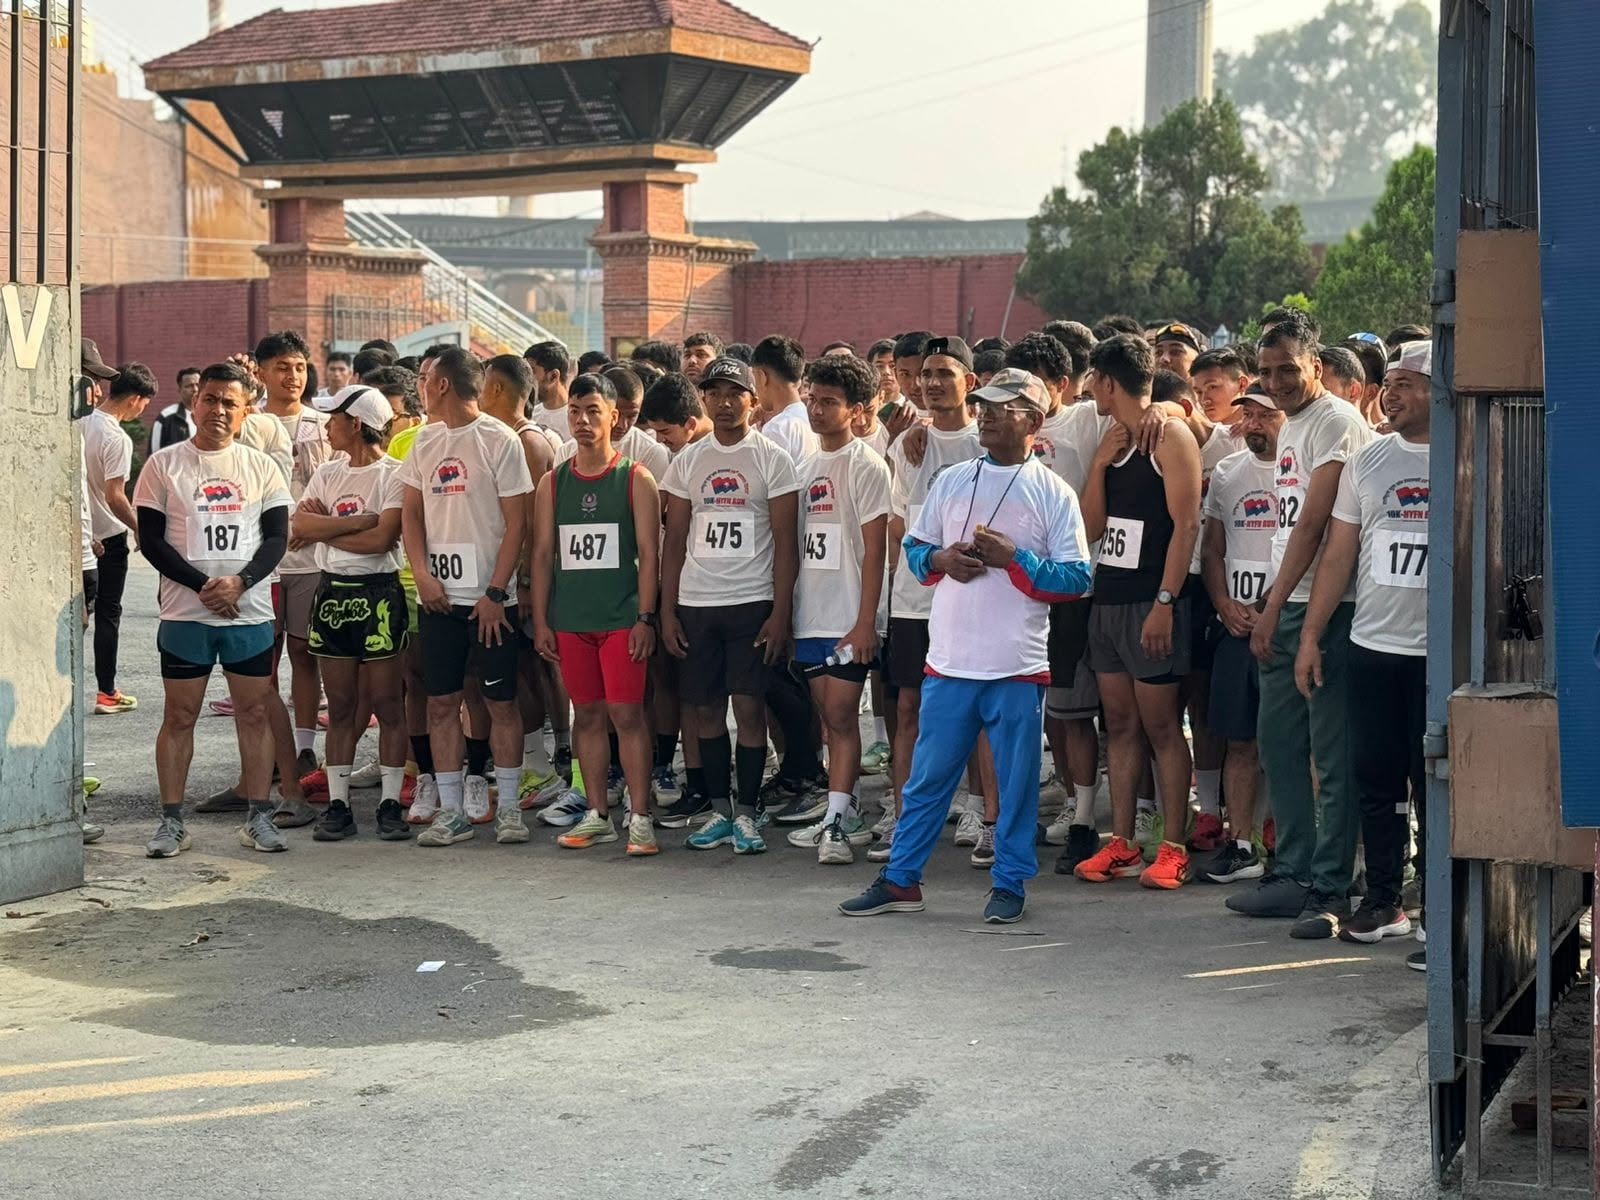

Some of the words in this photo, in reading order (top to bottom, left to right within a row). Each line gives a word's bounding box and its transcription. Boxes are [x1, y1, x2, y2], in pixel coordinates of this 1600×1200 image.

[1, 284, 53, 369] V
[204, 525, 240, 551] 187
[569, 533, 607, 560] 487
[705, 522, 742, 549] 475
[430, 553, 463, 580] 380
[1389, 542, 1428, 576] 177
[1232, 570, 1267, 601] 107
